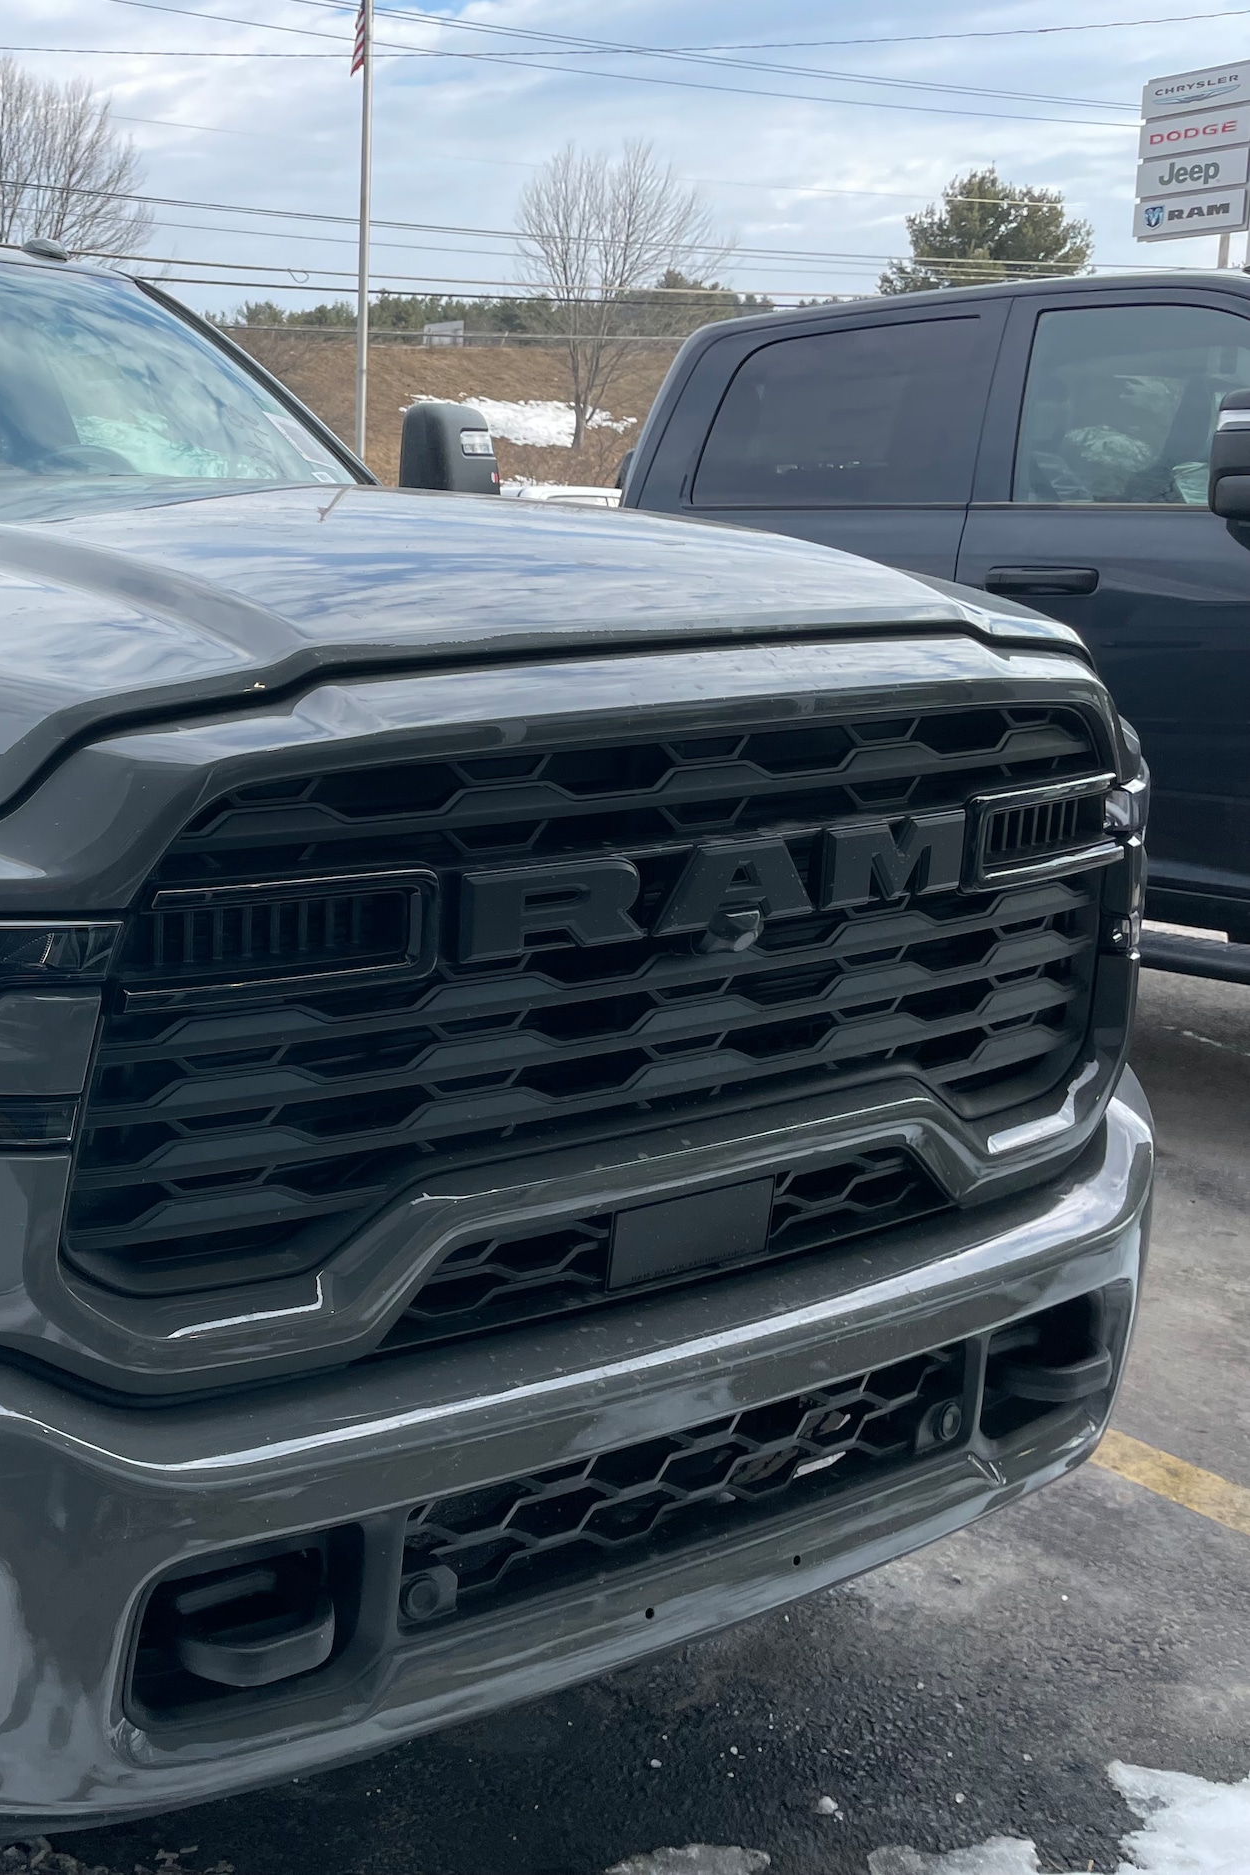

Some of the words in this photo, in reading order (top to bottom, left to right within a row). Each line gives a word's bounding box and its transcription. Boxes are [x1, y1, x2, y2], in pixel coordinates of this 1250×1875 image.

[1154, 74, 1239, 96] CHRYSLER
[1149, 120, 1239, 145] DODGE
[1158, 161, 1220, 186] Jeep
[1167, 202, 1230, 221] RAM
[458, 808, 966, 963] RAM
